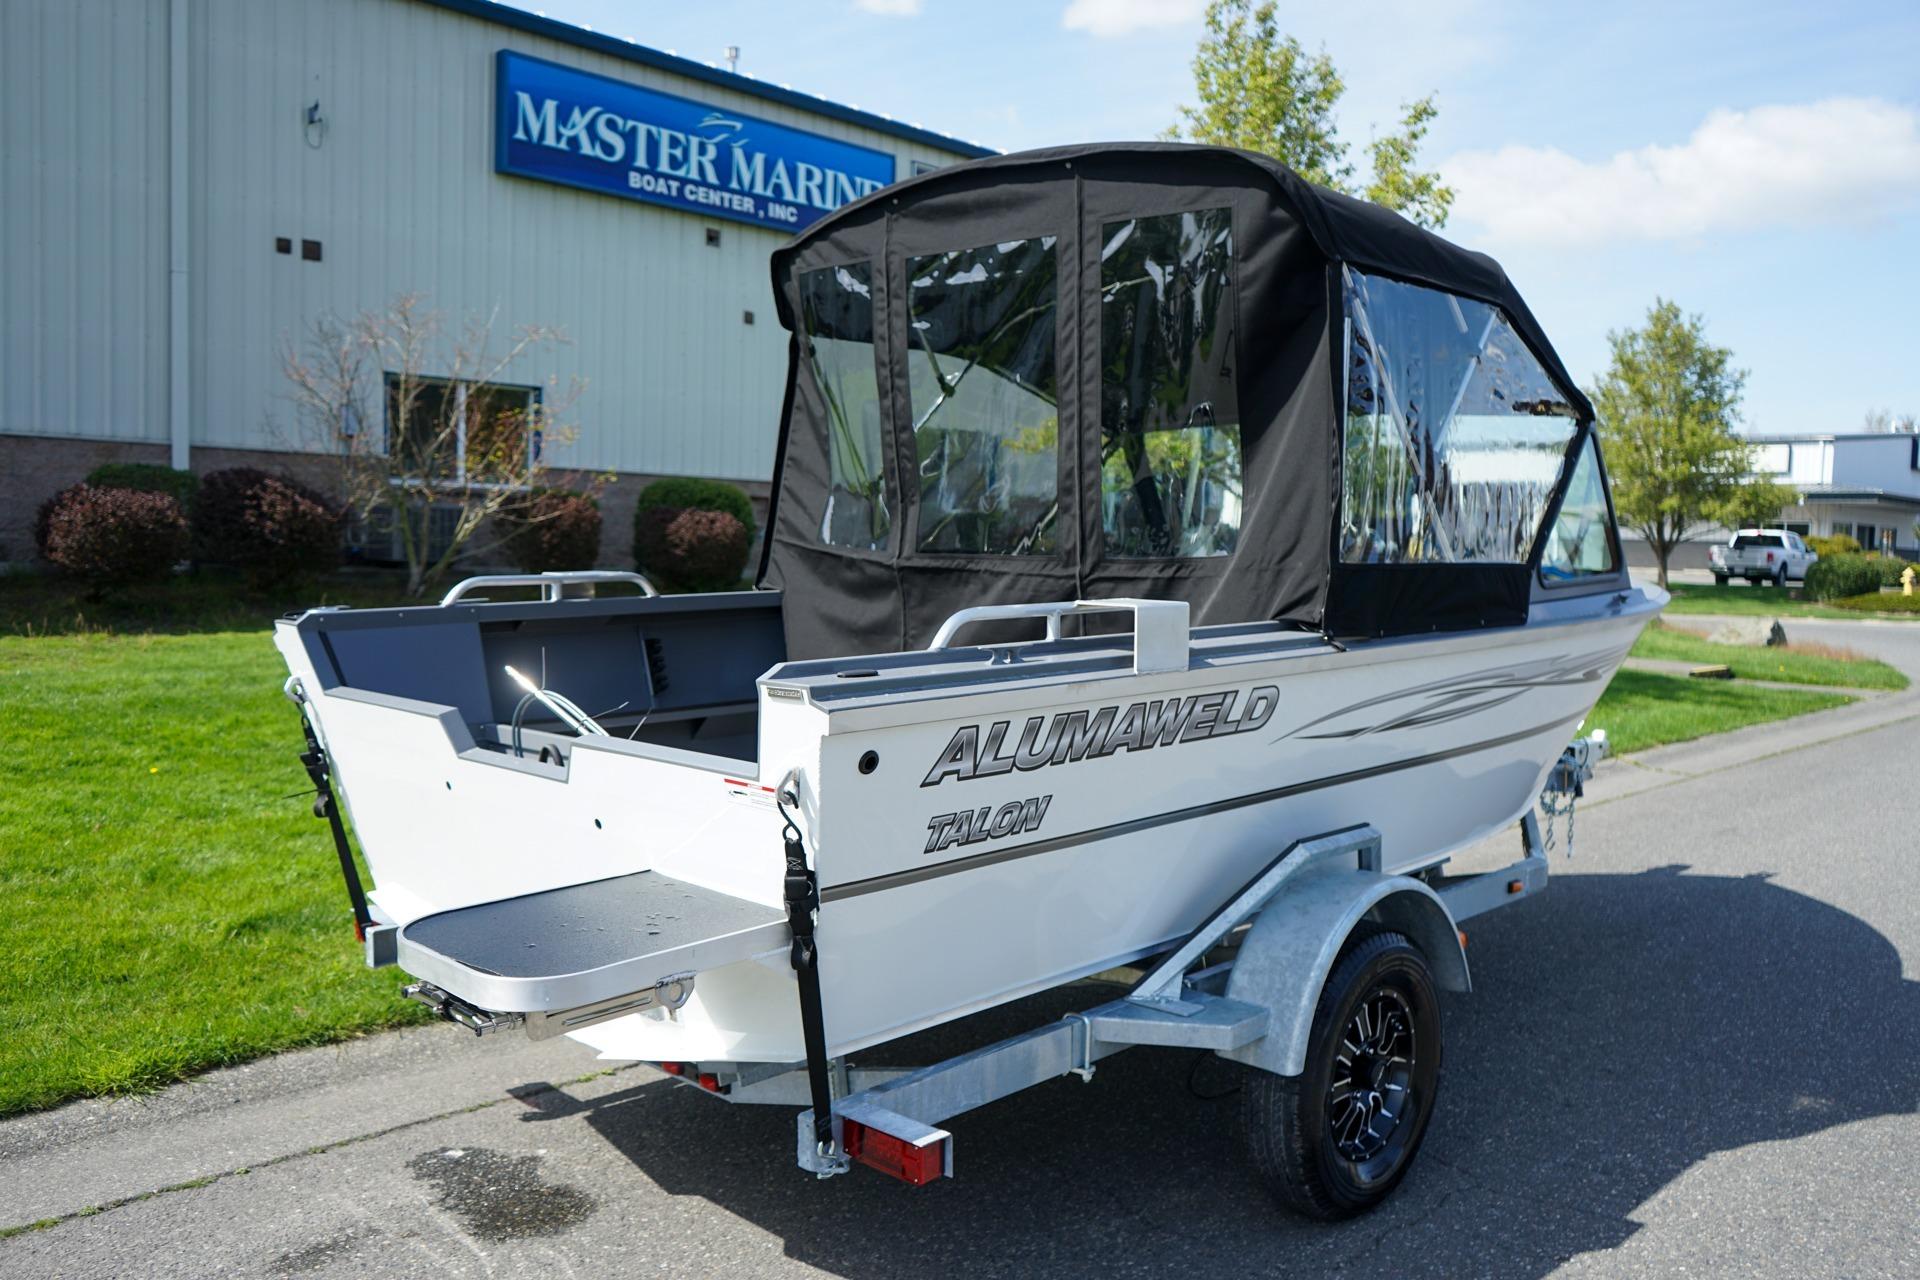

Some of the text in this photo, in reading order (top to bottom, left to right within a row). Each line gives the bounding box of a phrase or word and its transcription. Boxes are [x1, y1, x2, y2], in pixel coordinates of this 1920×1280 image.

[513, 91, 720, 185] MASTER
[628, 171, 681, 197] BOAT
[768, 202, 798, 223] INC
[920, 685, 1280, 788] ALUMAWELD
[924, 794, 1053, 854] TALON
